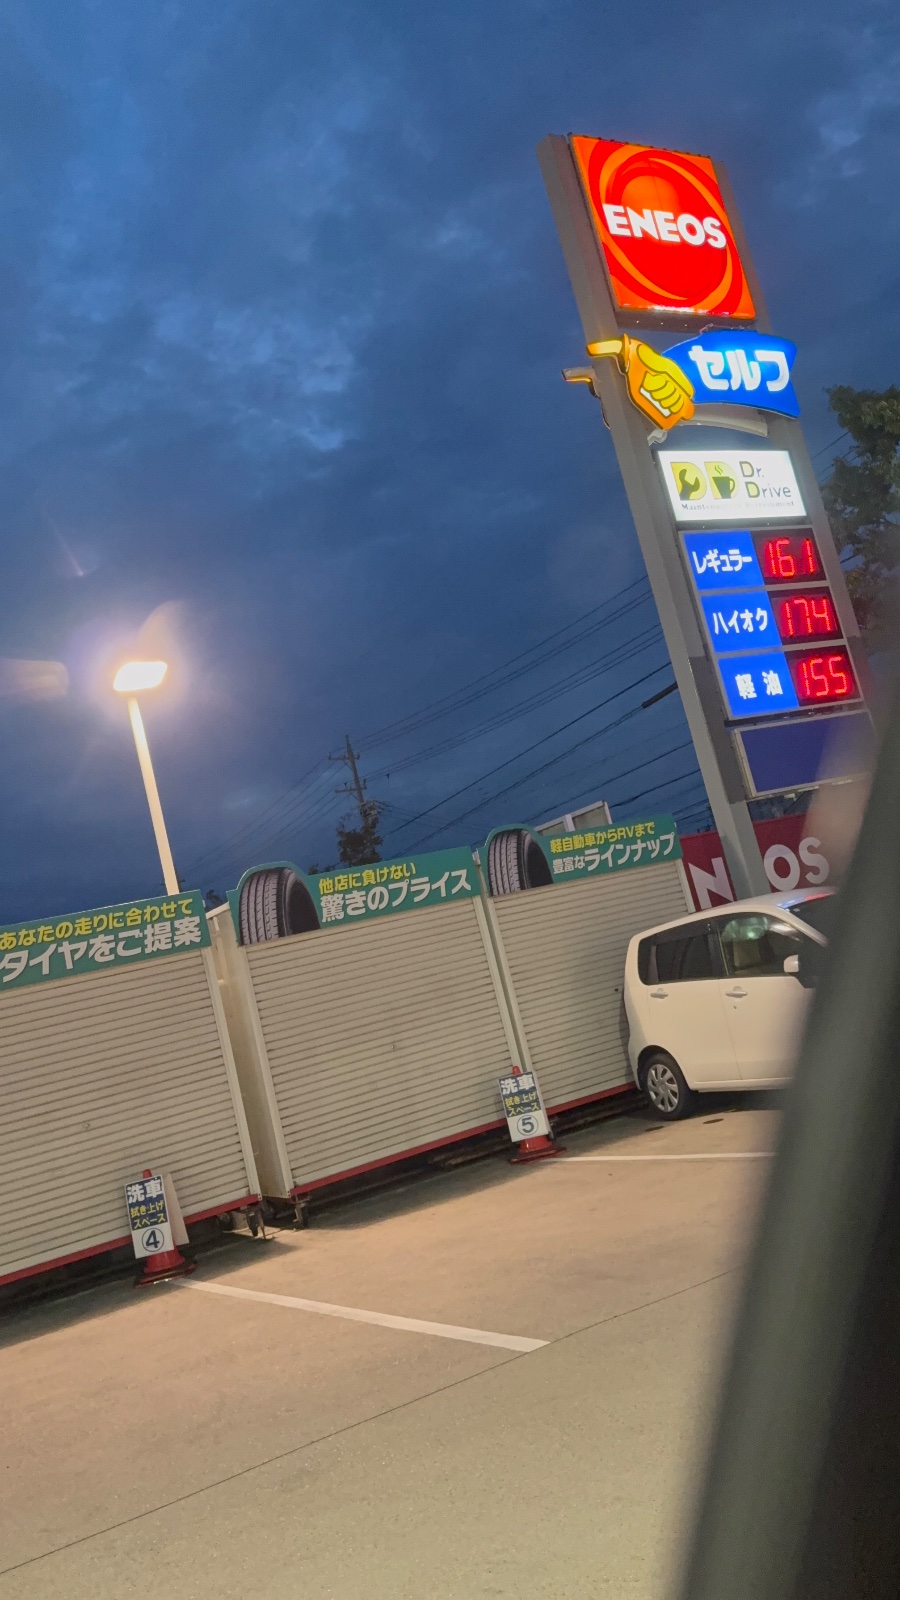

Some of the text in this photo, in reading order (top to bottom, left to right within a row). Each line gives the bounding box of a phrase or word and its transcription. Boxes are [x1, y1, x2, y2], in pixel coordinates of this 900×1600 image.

[602, 204, 726, 249] ENEOS
[688, 345, 790, 392] セルフ
[739, 461, 765, 478] Dr.
[745, 482, 791, 498] Drive
[692, 539, 816, 578] レギュラー 161
[712, 596, 832, 638] ハイオク 174
[735, 656, 848, 700] 軽油 155
[551, 821, 655, 854] 軽自動車からRVまで
[553, 832, 675, 875] 豊富なラインナップ
[318, 862, 417, 895] 他店に負けない
[688, 836, 830, 910] NOS
[320, 869, 472, 923] 驚きのプライス
[0, 898, 193, 950] あなたの走りに合わせて
[0, 915, 202, 983] タイヤをご提案
[500, 1074, 535, 1095] 洗車
[505, 1091, 537, 1107] 拭き上げ
[508, 1102, 540, 1117] スペース
[127, 1179, 163, 1203] 洗車
[130, 1200, 164, 1218] 拭き上げ
[133, 1213, 166, 1230] スペース
